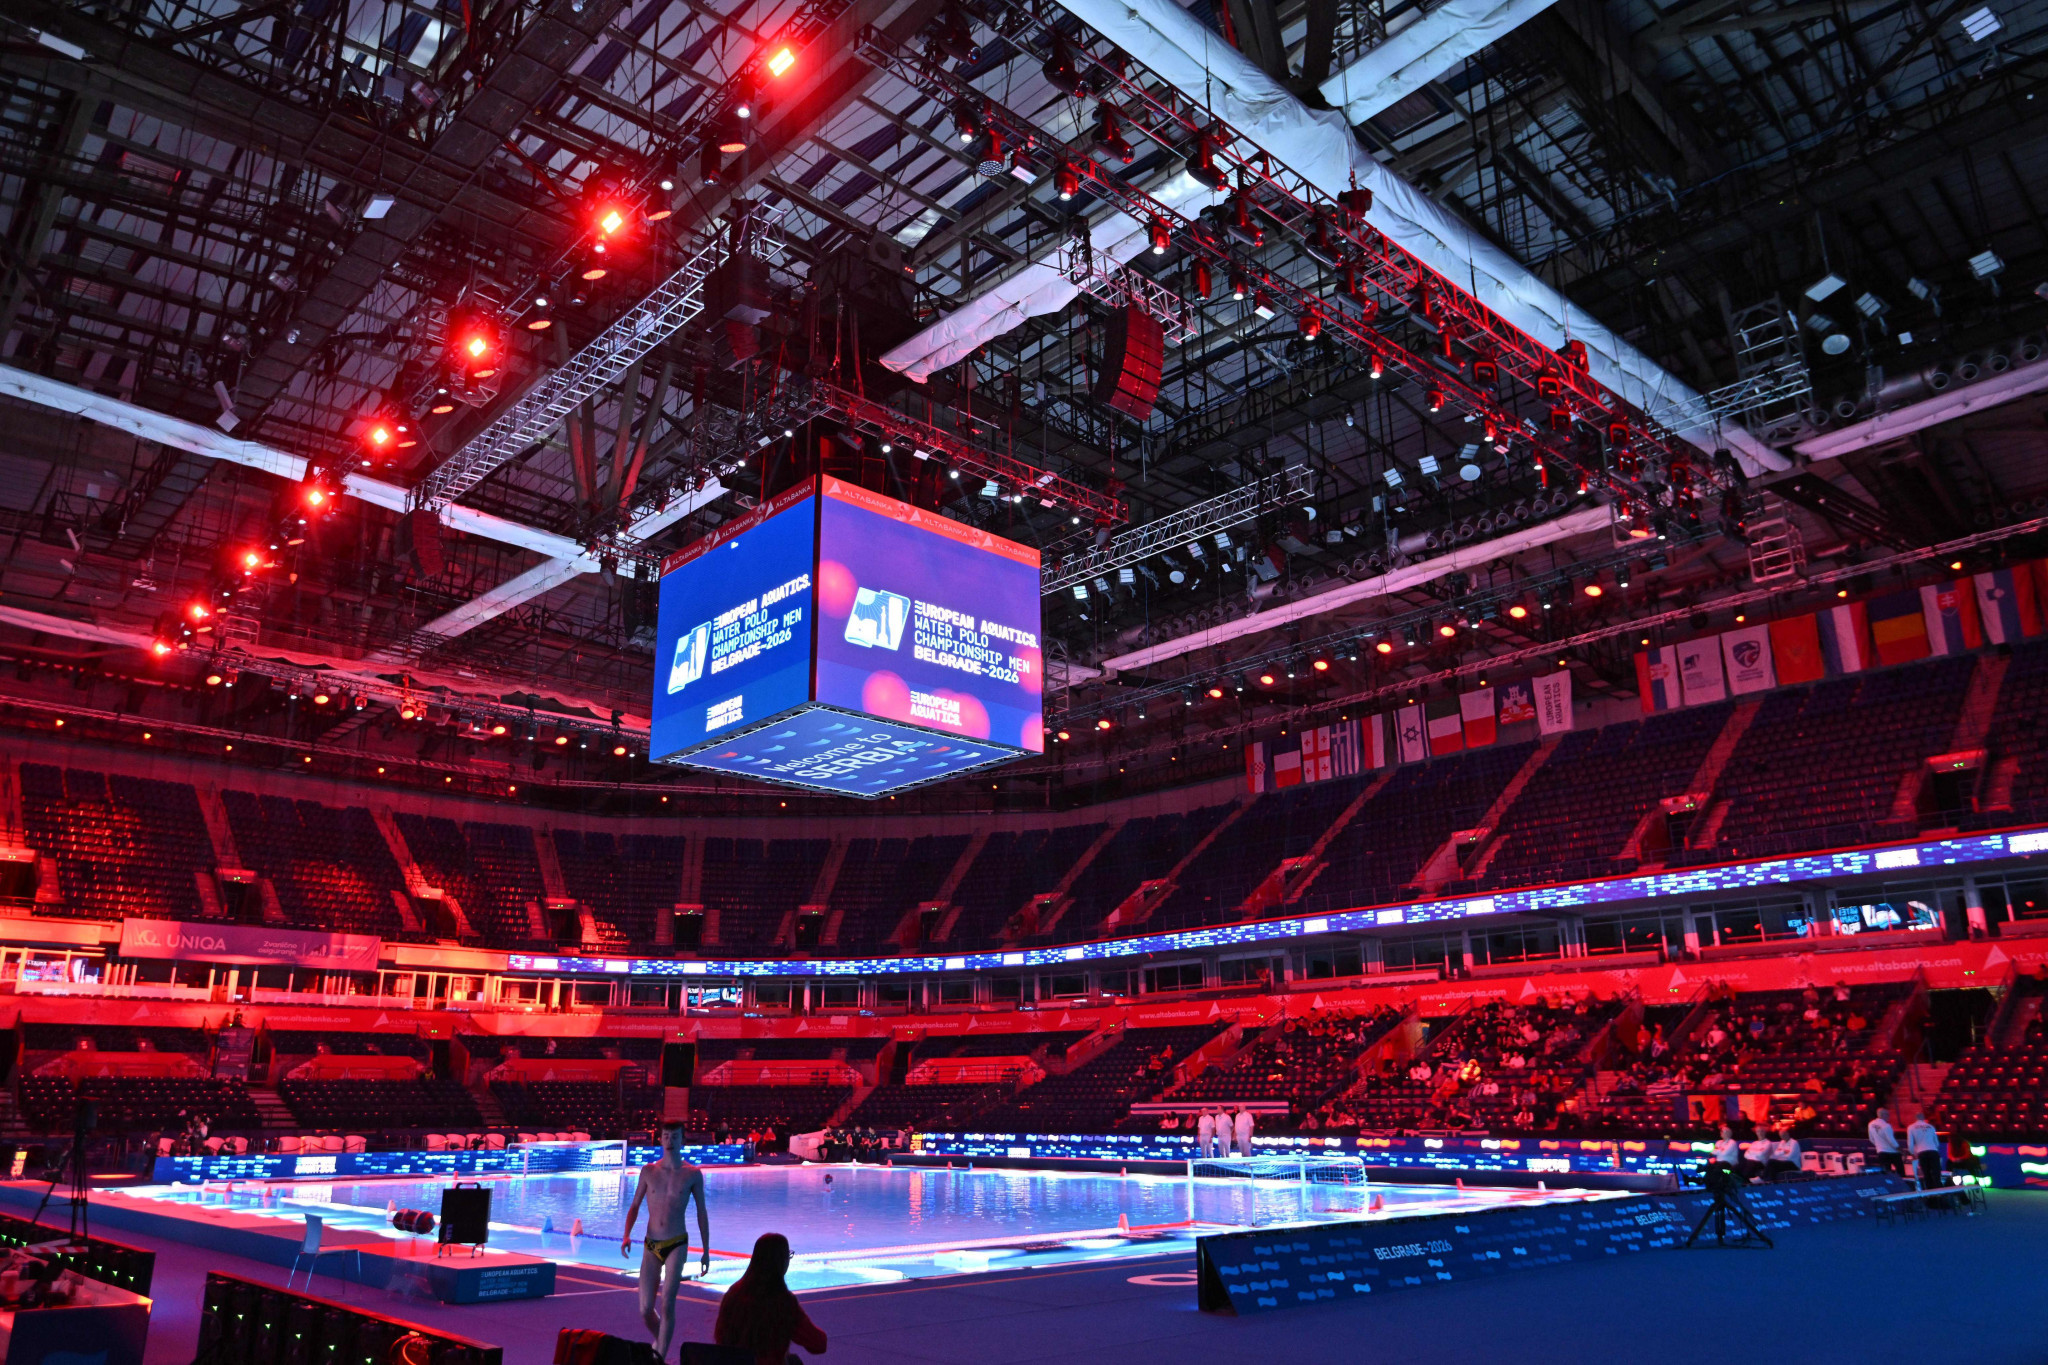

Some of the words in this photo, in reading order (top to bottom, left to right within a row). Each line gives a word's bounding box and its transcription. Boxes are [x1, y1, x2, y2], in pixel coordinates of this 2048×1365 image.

[775, 484, 811, 509] ALTABANKA
[844, 490, 893, 512] ALTABANKA
[722, 516, 754, 538] ALTABANKA
[924, 518, 968, 538] ALTABANKA
[672, 545, 702, 566] ALTABANKA
[995, 542, 1036, 561] ALTABANKA
[713, 598, 758, 631] EUROPEAN
[713, 622, 741, 646] WATER
[745, 608, 768, 632] POLO
[914, 600, 975, 630] EUROPEAN
[711, 618, 779, 660] CHAMPIONSHIP
[783, 607, 802, 628] MEN
[914, 614, 953, 638] WATER
[959, 628, 989, 648] POLO
[914, 630, 1003, 666] CHAMPIONSHIP
[1008, 655, 1030, 674] MEN
[910, 690, 960, 713] EUROPEAN
[763, 742, 865, 773] Welcome
[855, 733, 892, 744] to
[794, 740, 935, 779] SERBIA
[167, 934, 226, 951] UNIQA
